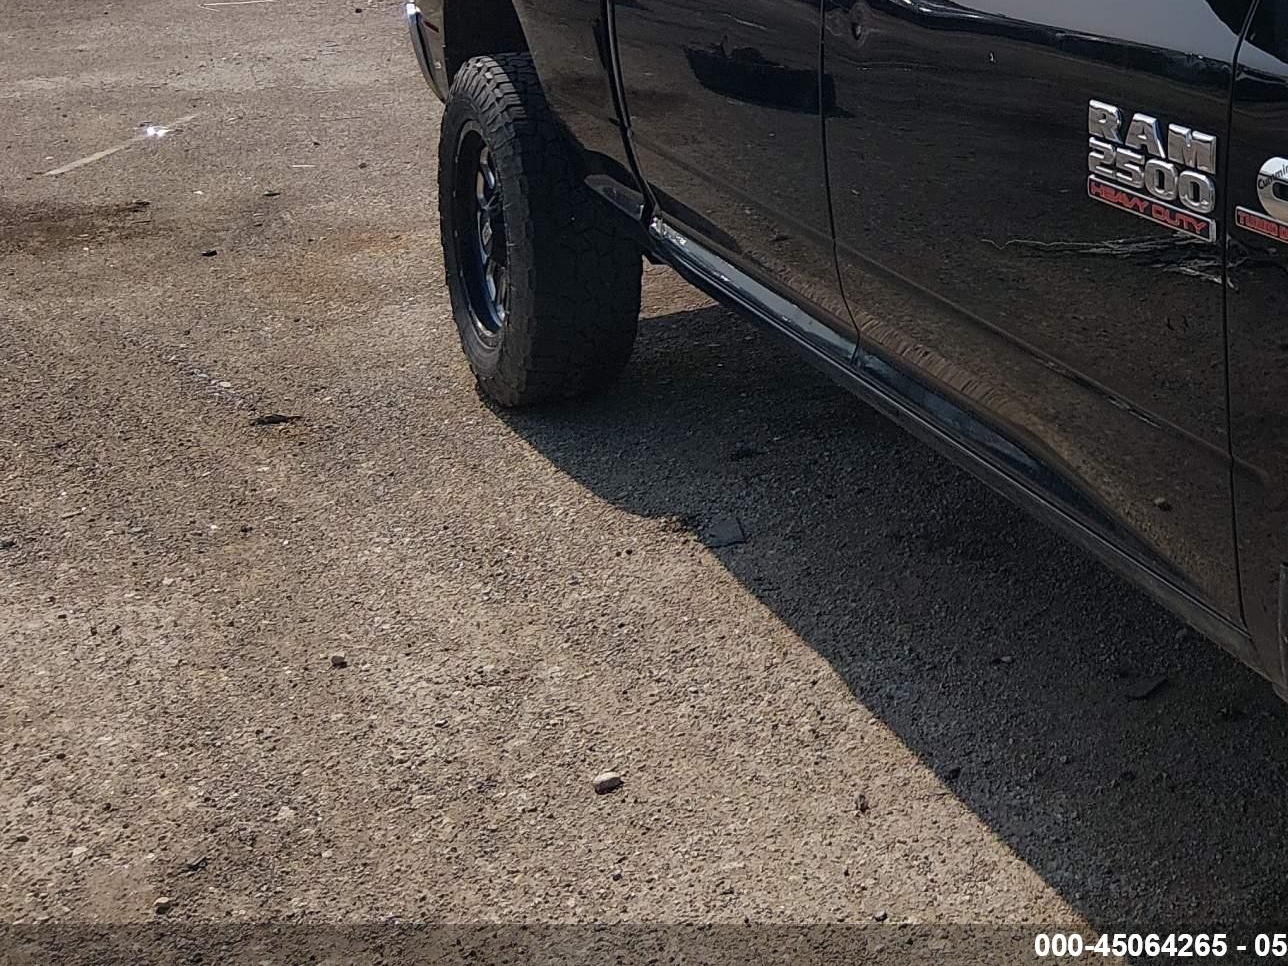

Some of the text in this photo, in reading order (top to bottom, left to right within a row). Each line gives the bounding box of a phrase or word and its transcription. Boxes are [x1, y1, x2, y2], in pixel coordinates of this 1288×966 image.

[1087, 136, 1216, 214] 2500
[1088, 98, 1217, 175] RAM
[1090, 181, 1209, 233] HEAVY DUTY
